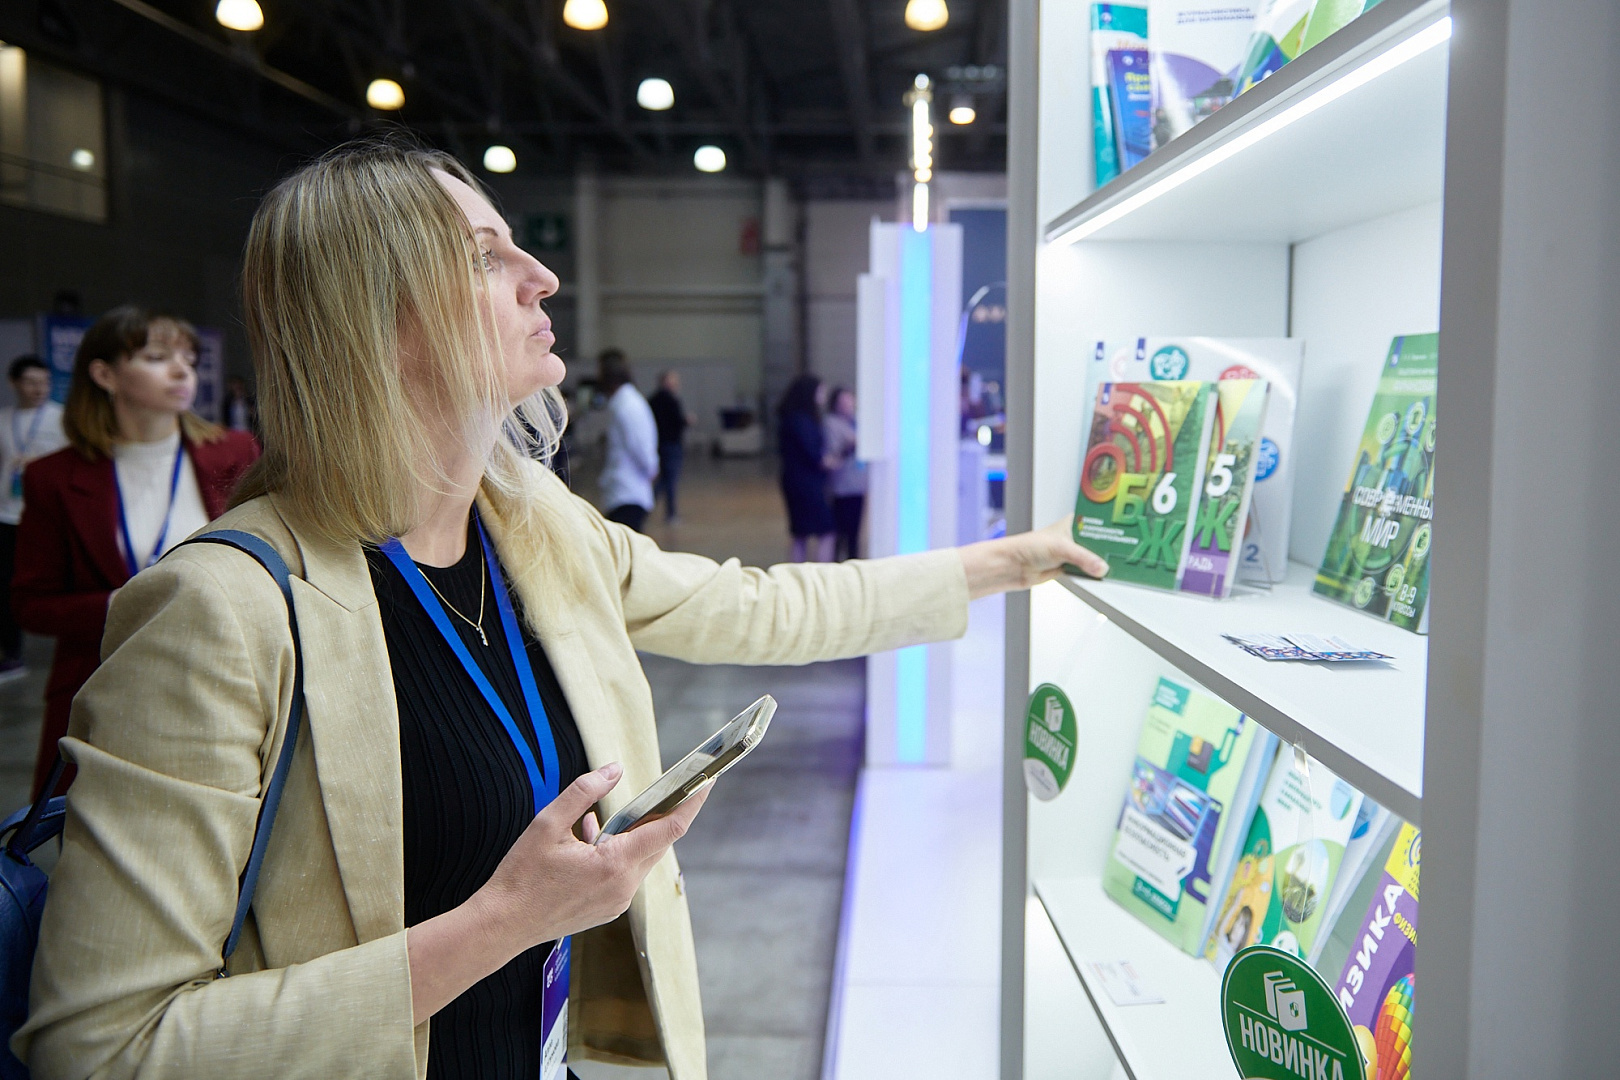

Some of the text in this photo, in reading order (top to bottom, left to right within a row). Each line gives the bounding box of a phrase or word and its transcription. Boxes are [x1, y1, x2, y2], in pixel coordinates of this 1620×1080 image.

[1152, 472, 1178, 514] 6
[1205, 453, 1236, 497] 5
[1352, 485, 1433, 521] СОВРЕМЕННЫ
[1360, 515, 1400, 550] МИР
[1188, 554, 1214, 571] РАДЬ
[1245, 543, 1259, 562] 2
[1028, 718, 1070, 771] НОВИНКА
[1393, 911, 1418, 948] ФИЗИ
[1339, 883, 1405, 1018] ИЗИКА
[1239, 1012, 1345, 1080] НОВИНКА
